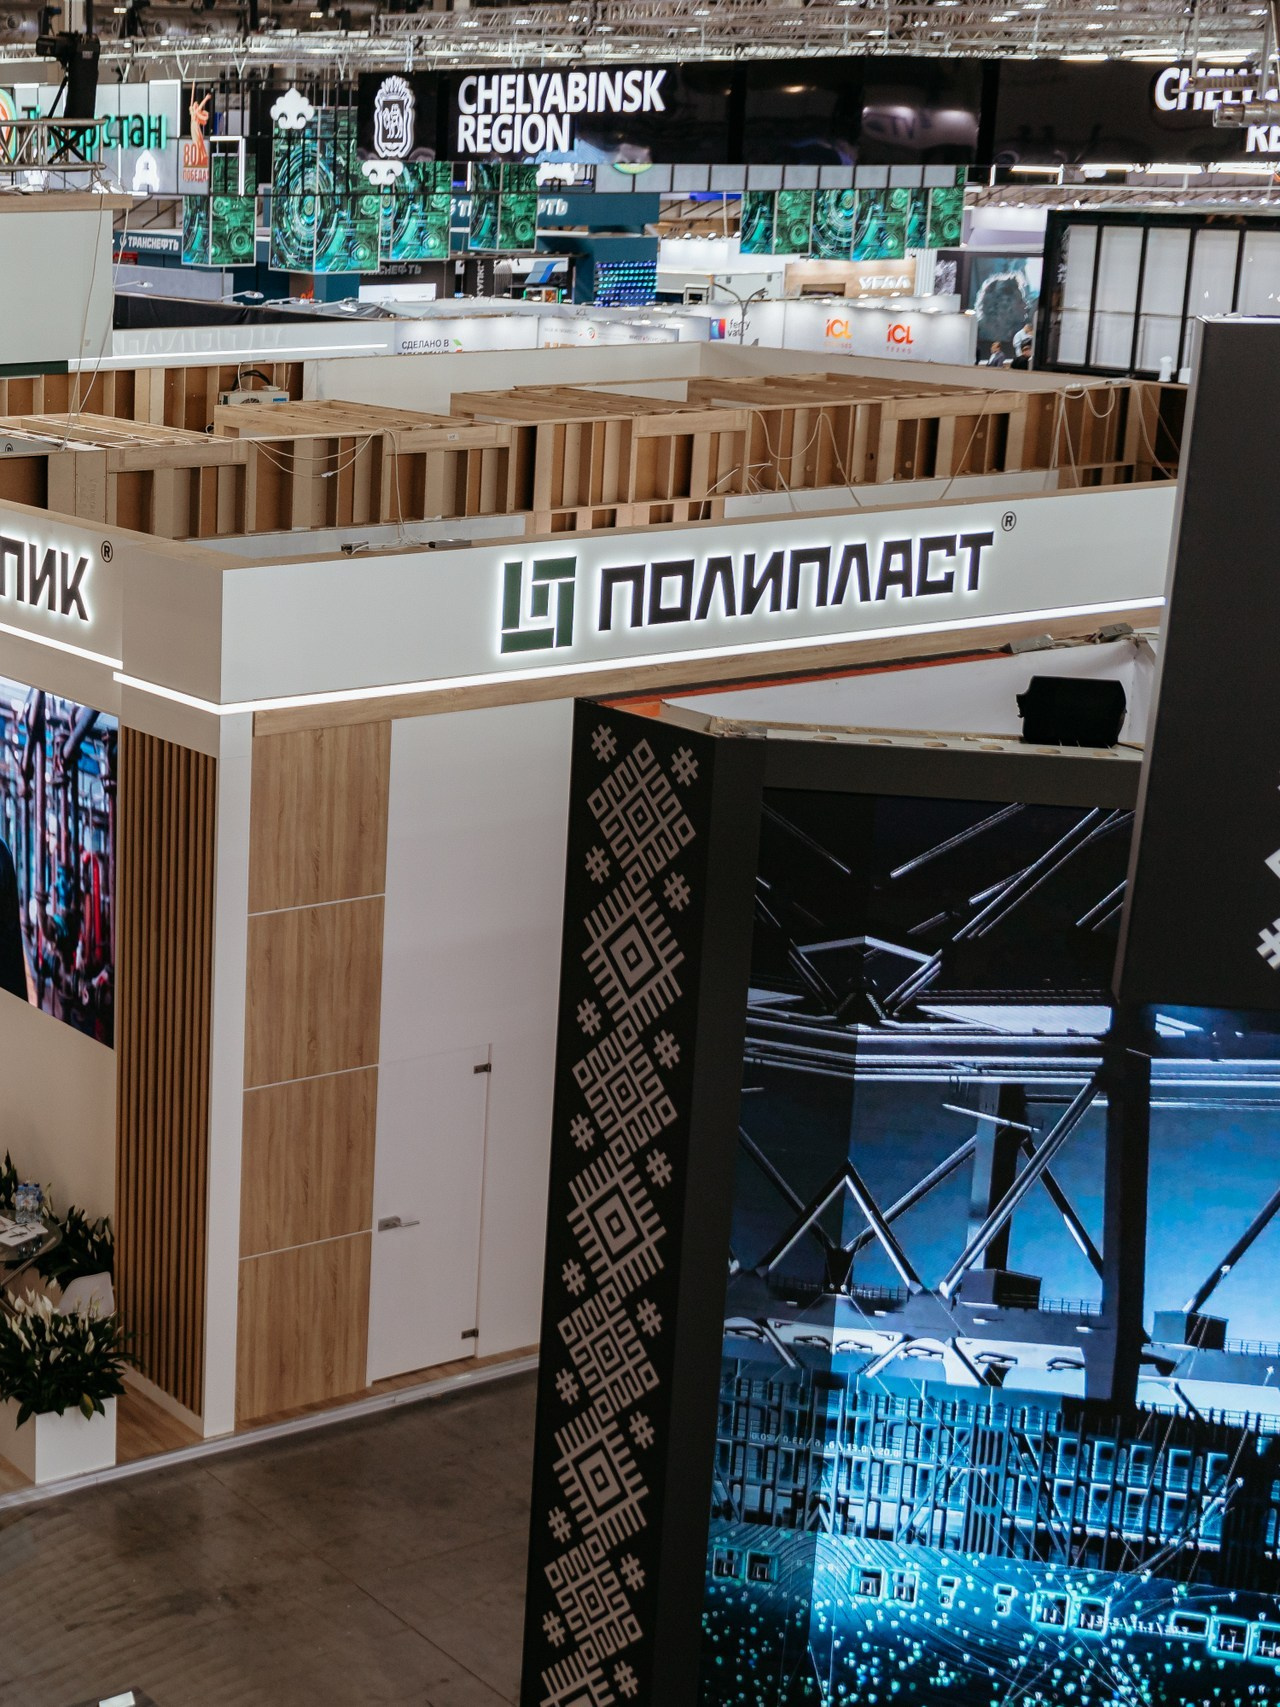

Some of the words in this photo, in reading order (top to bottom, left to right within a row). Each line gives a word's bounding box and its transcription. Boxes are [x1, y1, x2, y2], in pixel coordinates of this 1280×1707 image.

[457, 69, 667, 115] CHELYABINSK
[457, 113, 571, 154] REGION
[128, 235, 179, 251] ТРАНСНЕФТЬ
[401, 339, 442, 350] СДЕЛАНО
[443, 338, 450, 348] В
[598, 530, 994, 631] ПОЛИПЛАСТ
